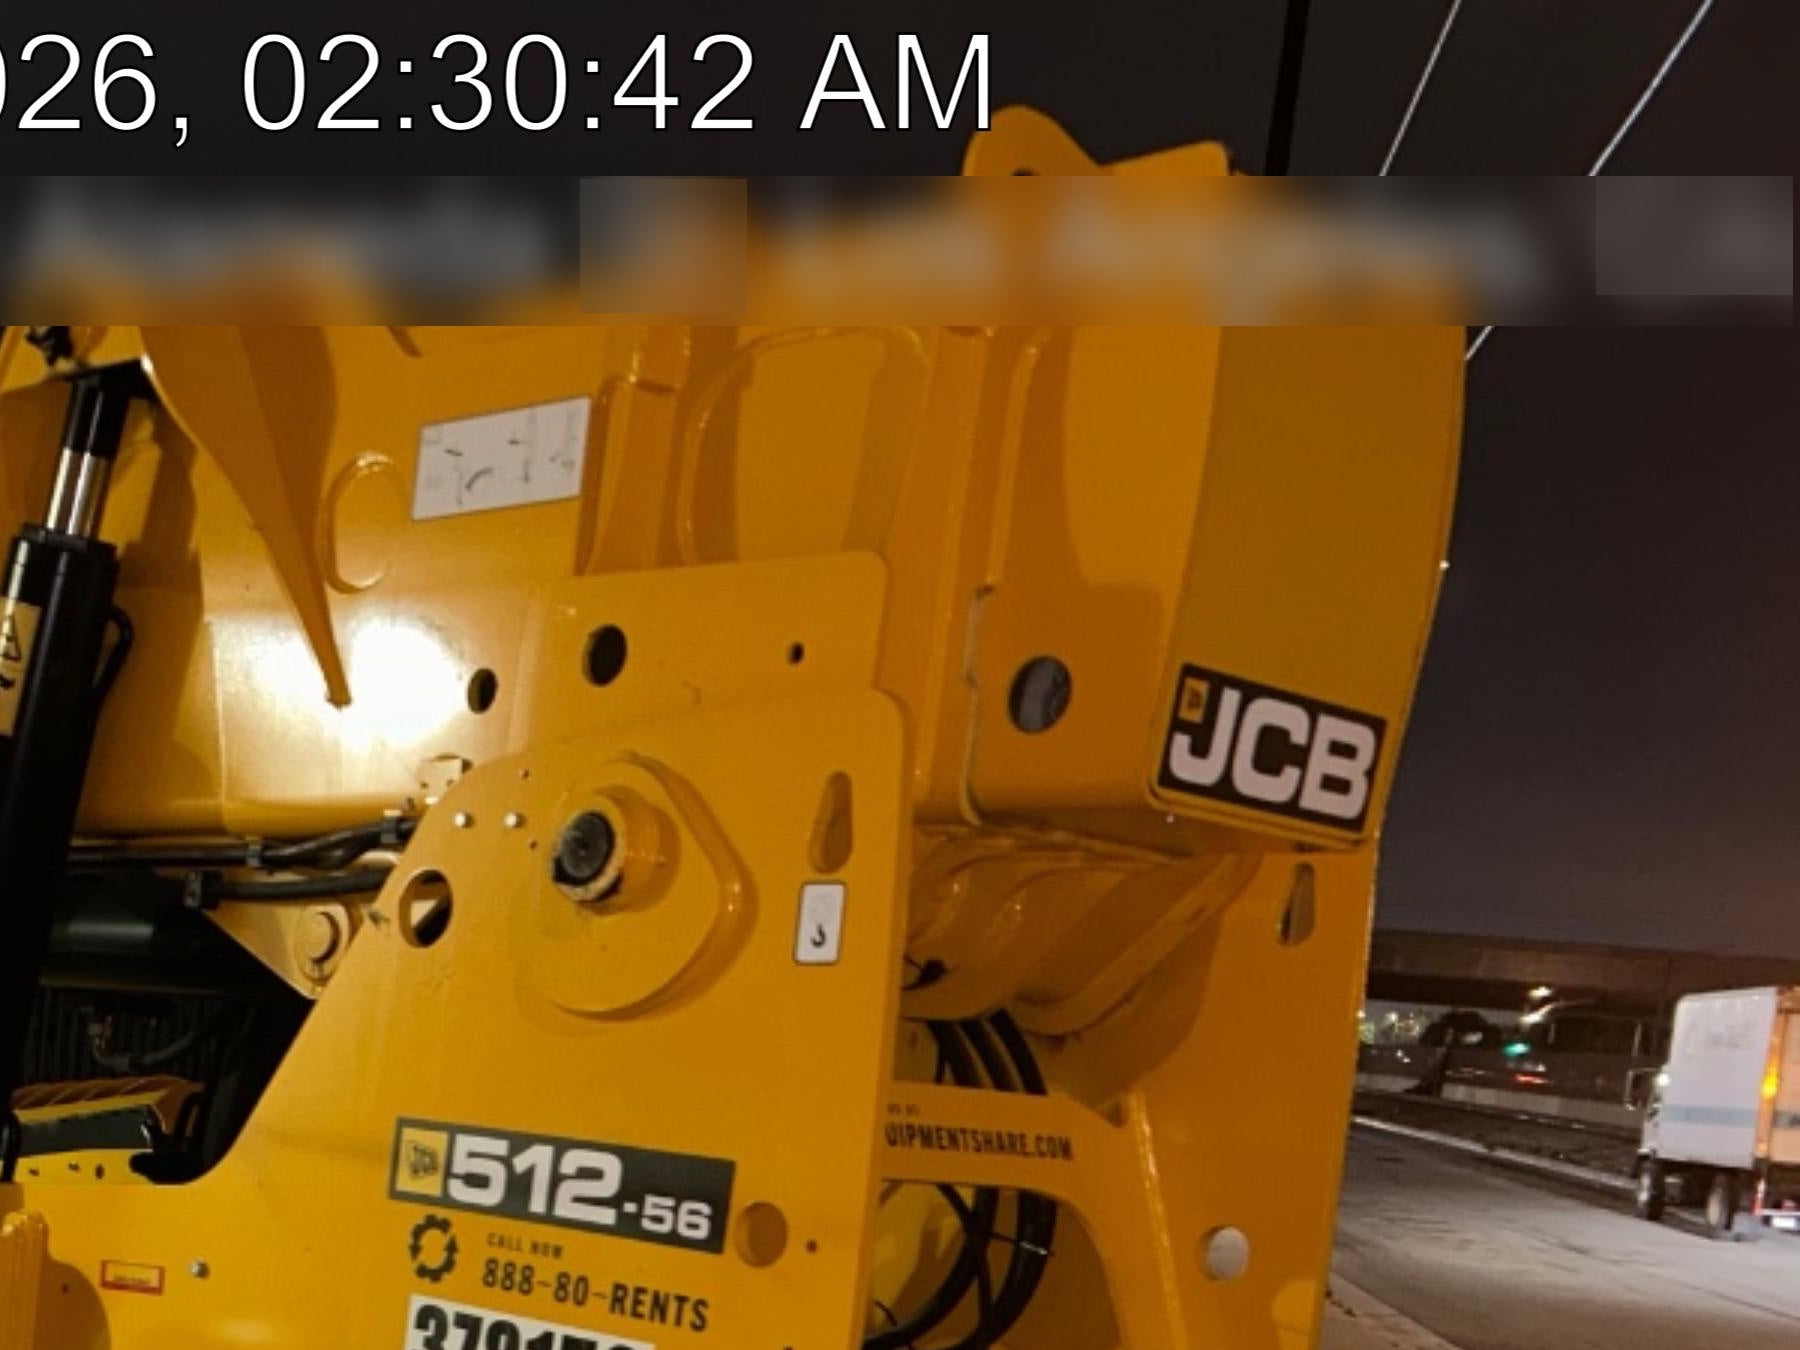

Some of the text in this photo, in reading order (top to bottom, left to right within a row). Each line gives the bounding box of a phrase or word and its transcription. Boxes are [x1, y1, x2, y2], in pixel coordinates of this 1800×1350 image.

[1168, 685, 1377, 820] JCB
[884, 1121, 1074, 1161] UIPMENTSHARE.COM
[447, 1133, 713, 1240] 512-56
[486, 1231, 565, 1260] CALL NOW
[481, 1256, 710, 1333] 888-80-RENTS
